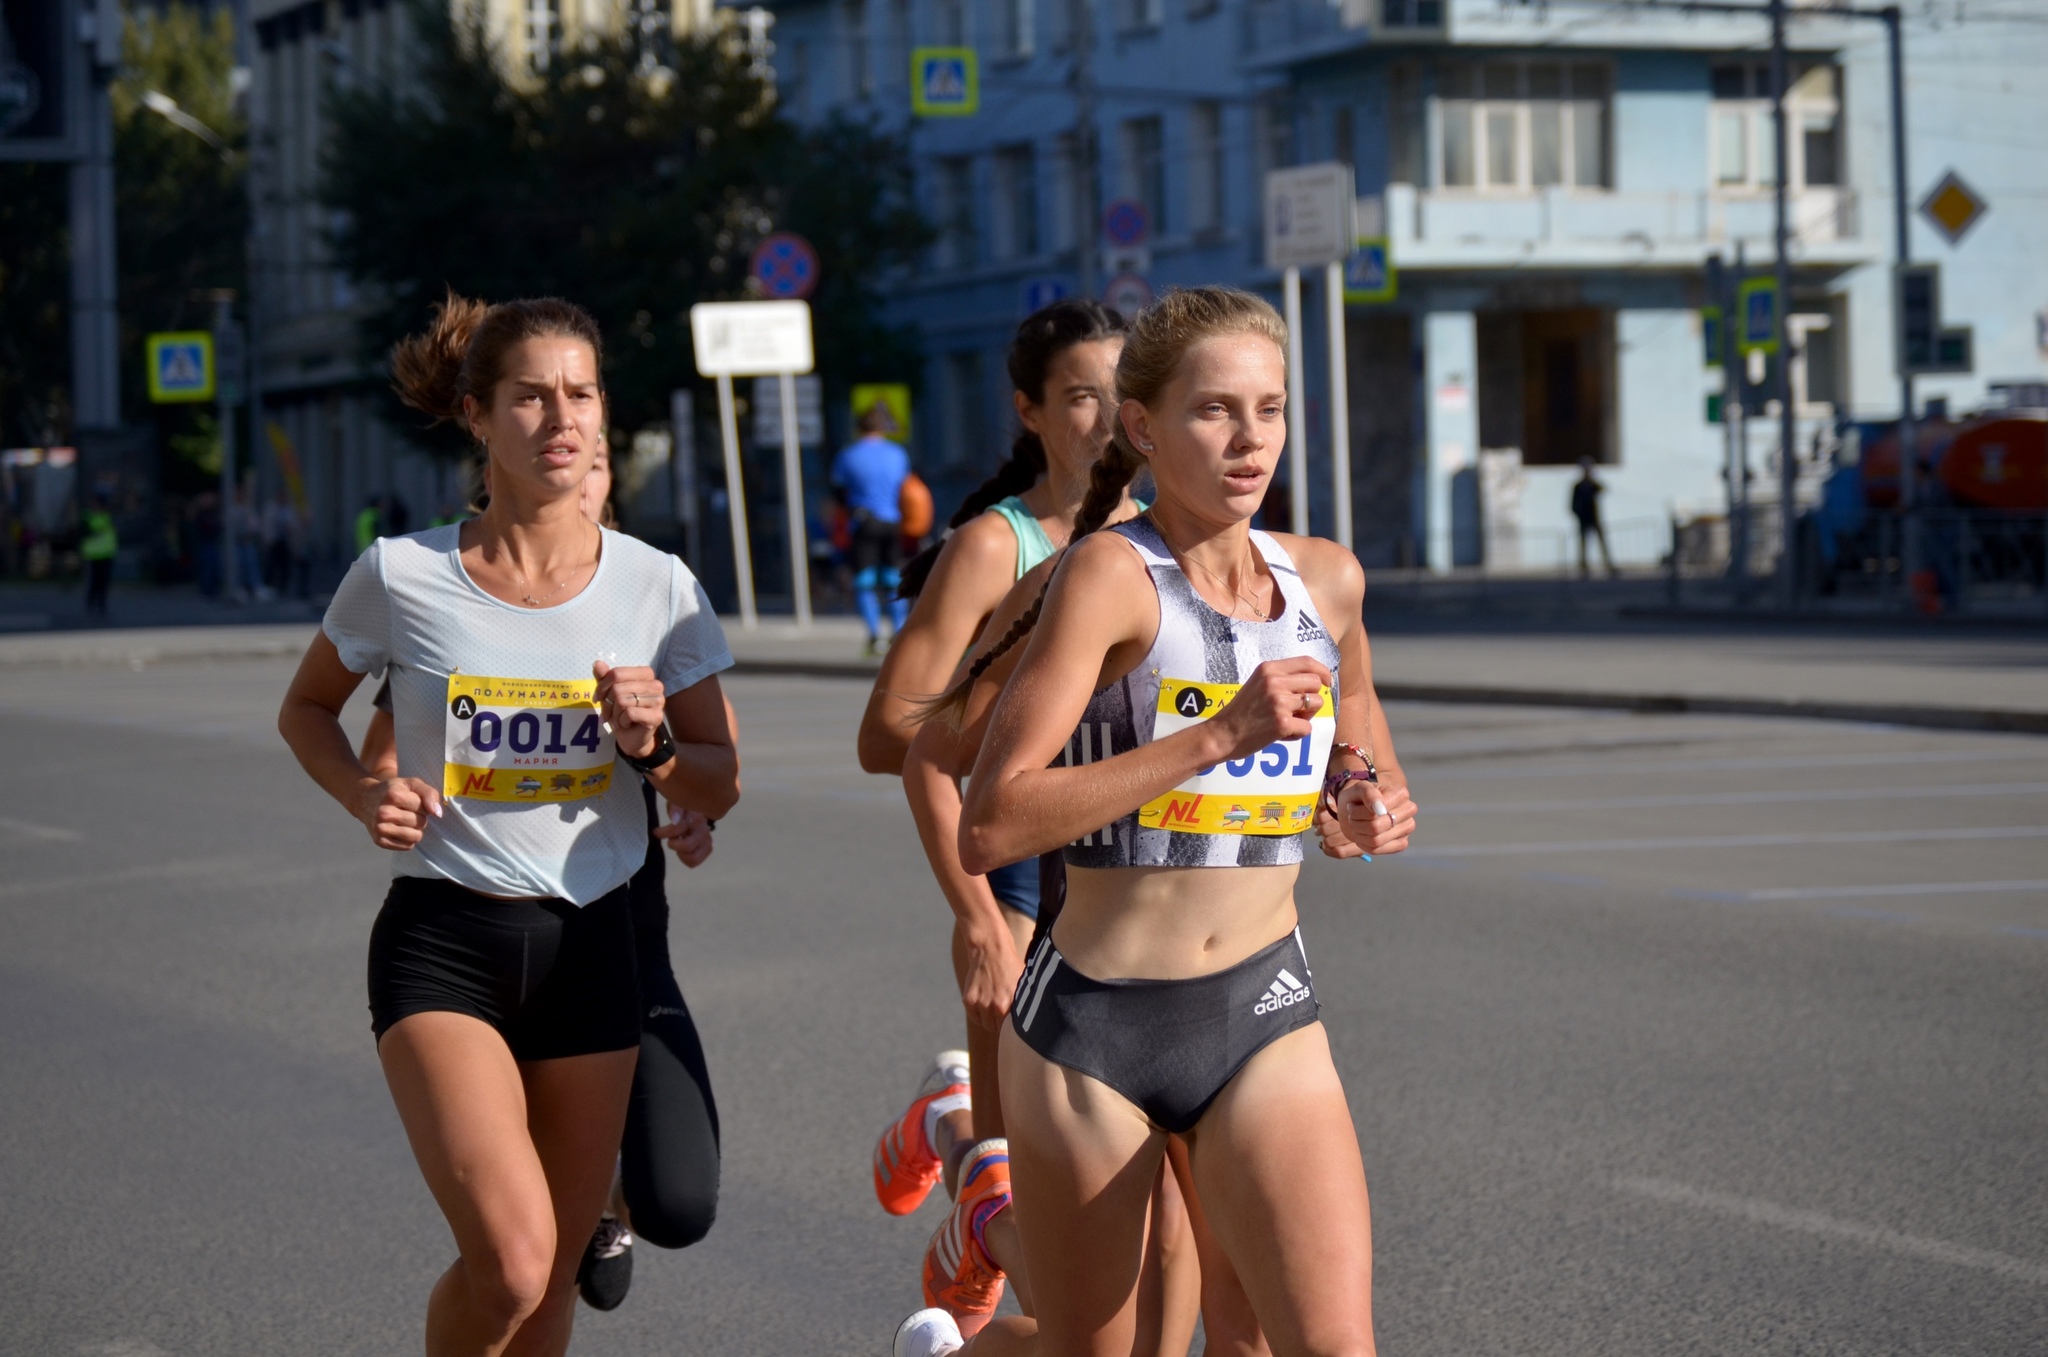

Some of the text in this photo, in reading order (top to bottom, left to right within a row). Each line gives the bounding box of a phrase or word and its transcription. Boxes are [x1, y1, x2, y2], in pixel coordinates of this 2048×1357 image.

[474, 688, 591, 700] ПОЛУМАРАФОН
[470, 711, 601, 754] 0014
[514, 757, 559, 765] МАРИЯ
[462, 768, 496, 796] NL
[1158, 794, 1204, 828] NL
[1254, 986, 1310, 1015] adidas
